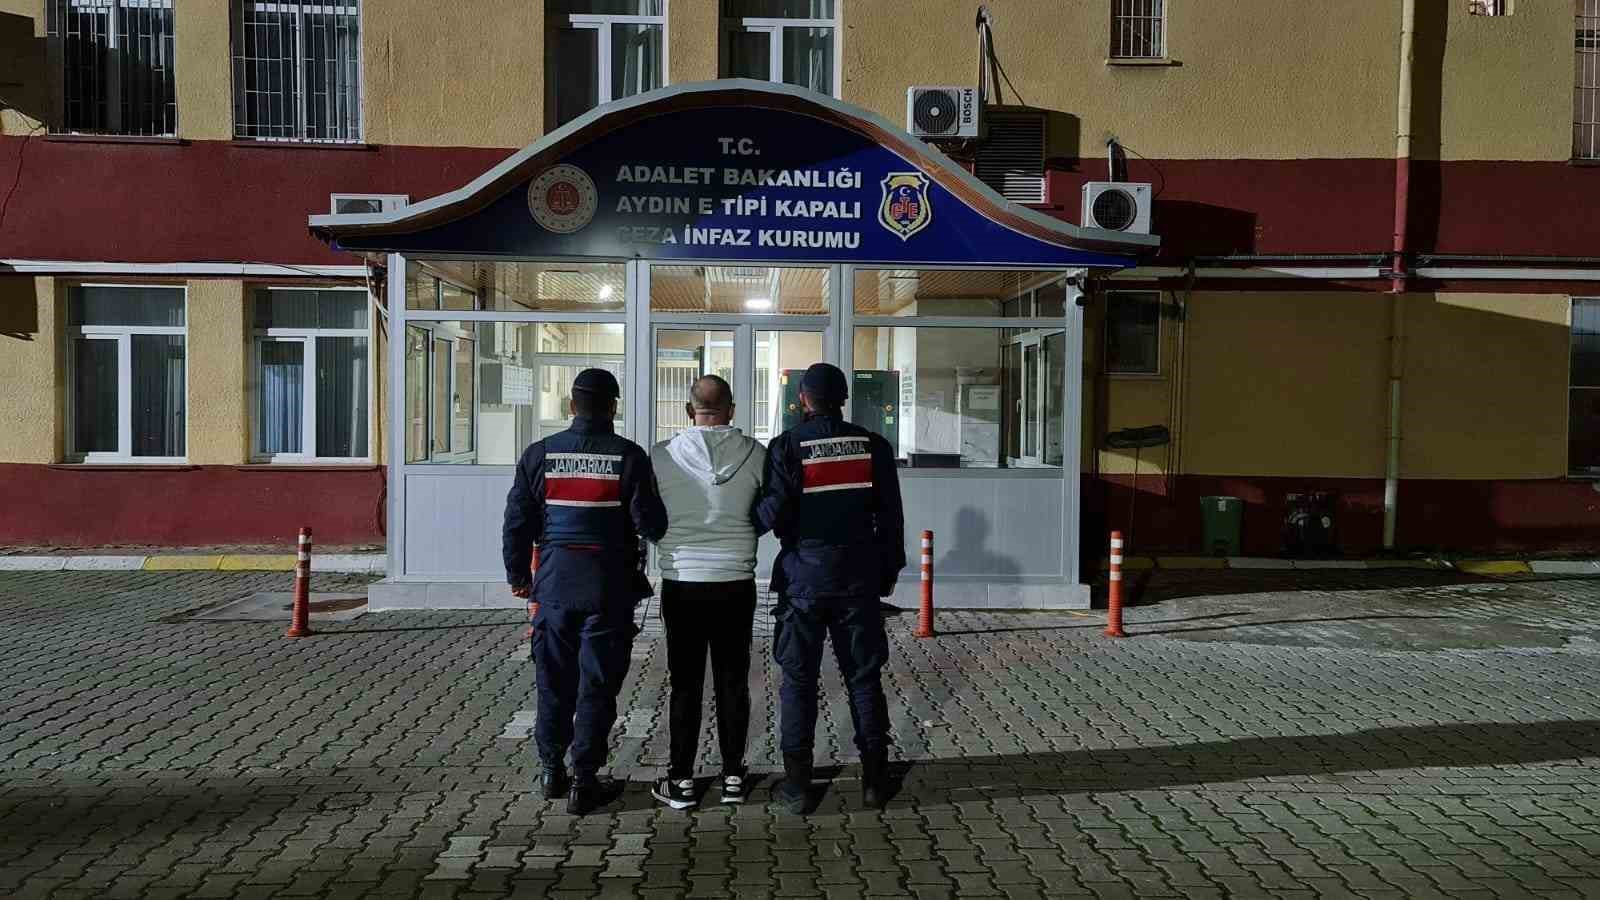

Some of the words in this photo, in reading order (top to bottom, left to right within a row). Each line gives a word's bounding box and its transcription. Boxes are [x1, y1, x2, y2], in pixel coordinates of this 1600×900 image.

[963, 88, 973, 124] BOSCH
[718, 137, 761, 155] T.C.
[616, 165, 715, 185] ADALET
[723, 167, 862, 189] BAKANLIĞI
[616, 196, 690, 214] AYDIN
[699, 198, 713, 214] E
[721, 195, 767, 217] TİPİ
[775, 200, 861, 219] KAPALI
[684, 224, 752, 246] İNFAZ
[758, 230, 861, 249] KURUMU
[551, 458, 614, 474] JANDARMA
